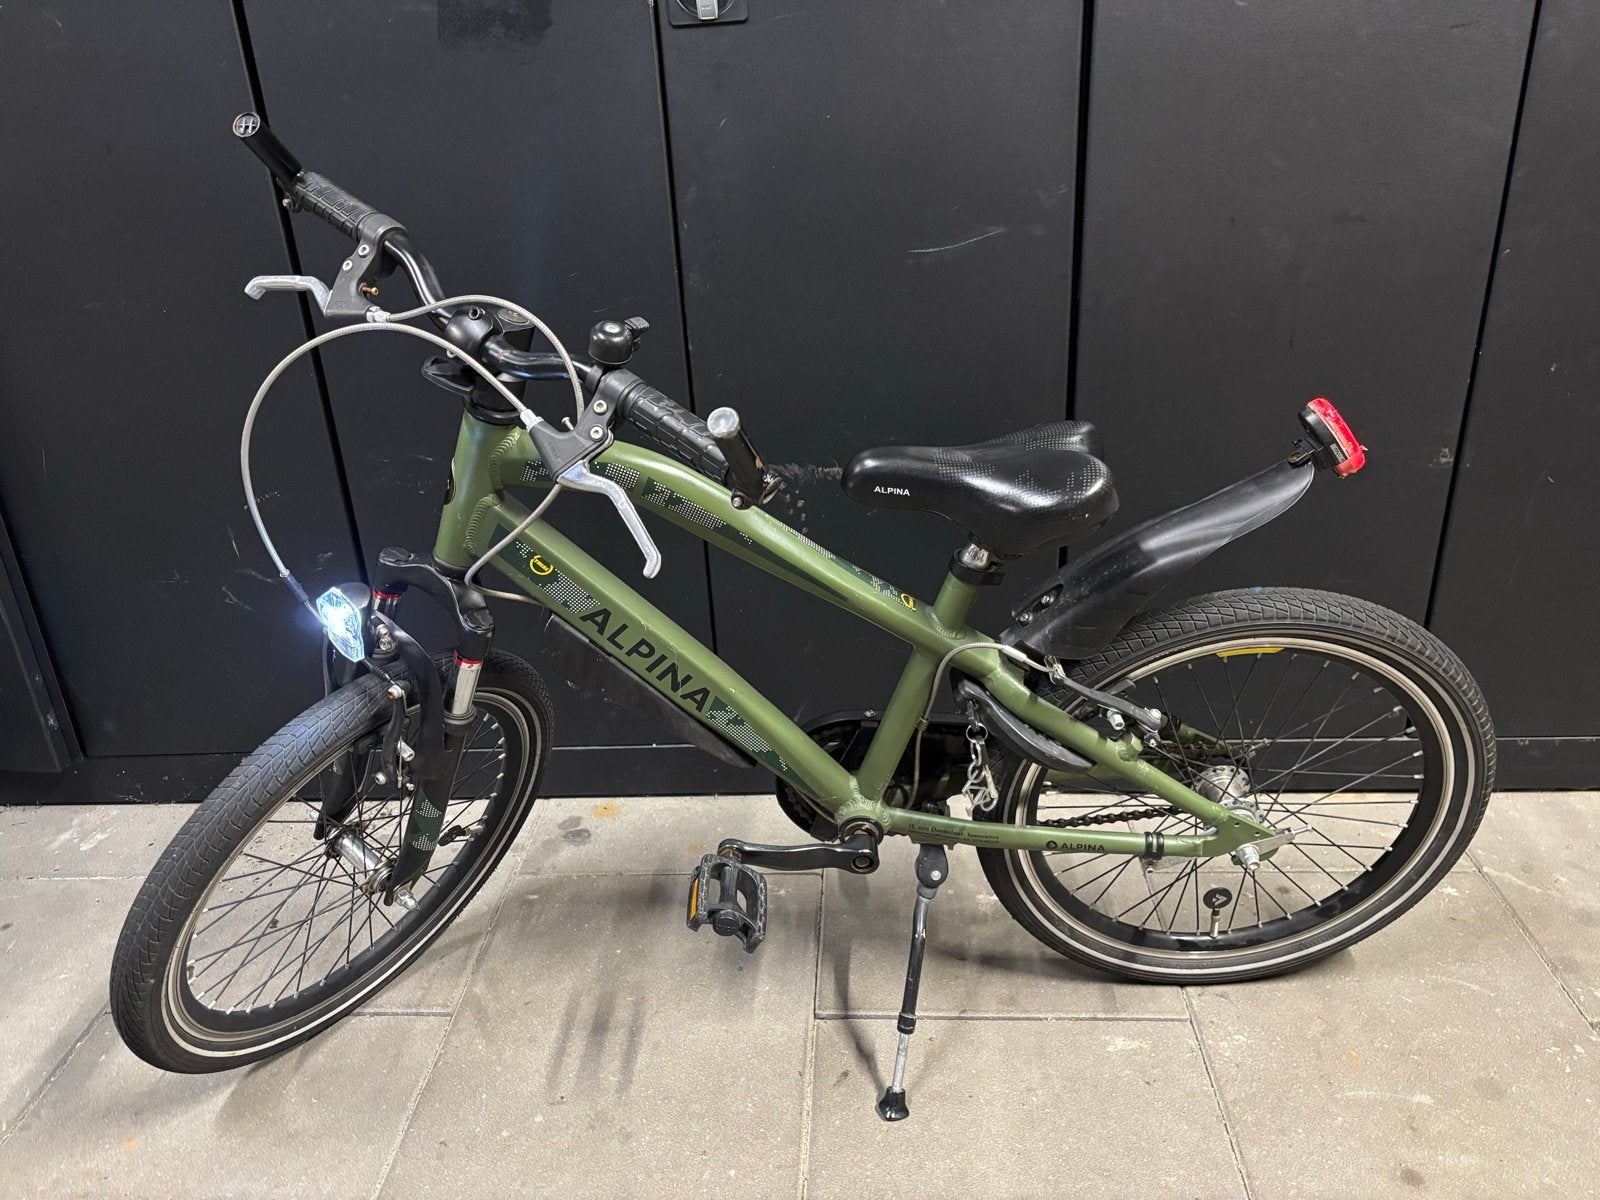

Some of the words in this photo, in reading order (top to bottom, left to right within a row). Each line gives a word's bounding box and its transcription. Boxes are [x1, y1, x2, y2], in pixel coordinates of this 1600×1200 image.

[873, 485, 911, 497] ALPINA
[579, 608, 711, 713] ALPINA
[1061, 842, 1106, 852] ALPINA
